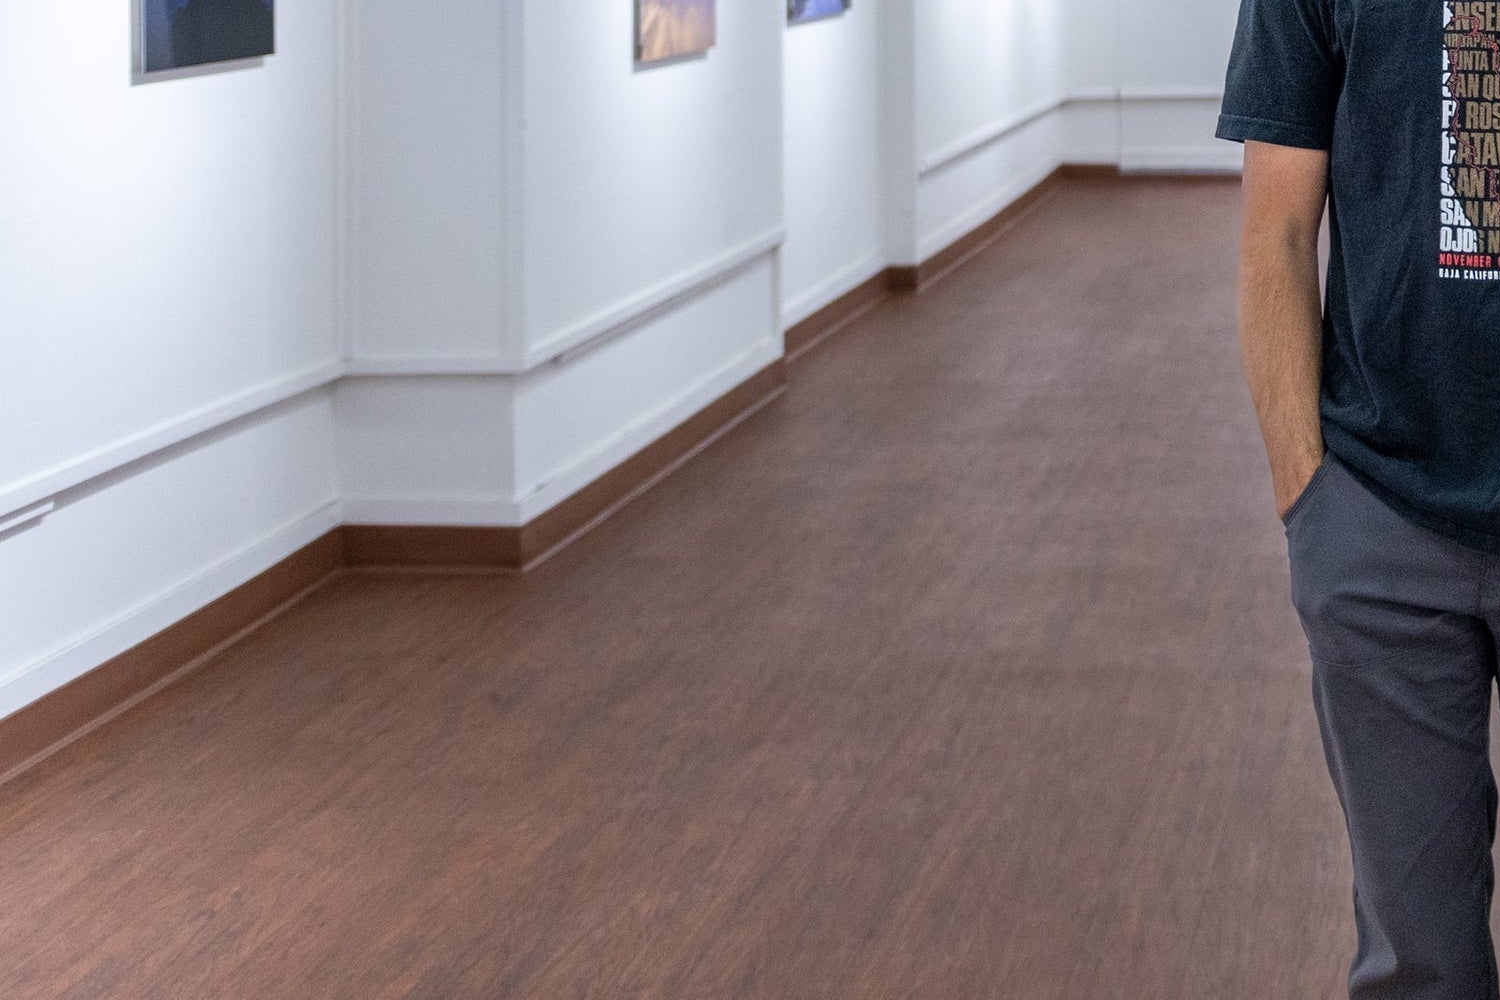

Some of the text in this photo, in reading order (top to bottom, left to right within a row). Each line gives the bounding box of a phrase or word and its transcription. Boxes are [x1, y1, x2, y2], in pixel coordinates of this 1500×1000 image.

[1442, 72, 1480, 98] SAN
[1441, 166, 1485, 199] SAN
[1441, 198, 1479, 227] SAN
[1439, 253, 1492, 267] NOVEMBER
[1439, 268, 1460, 279] BAJA
